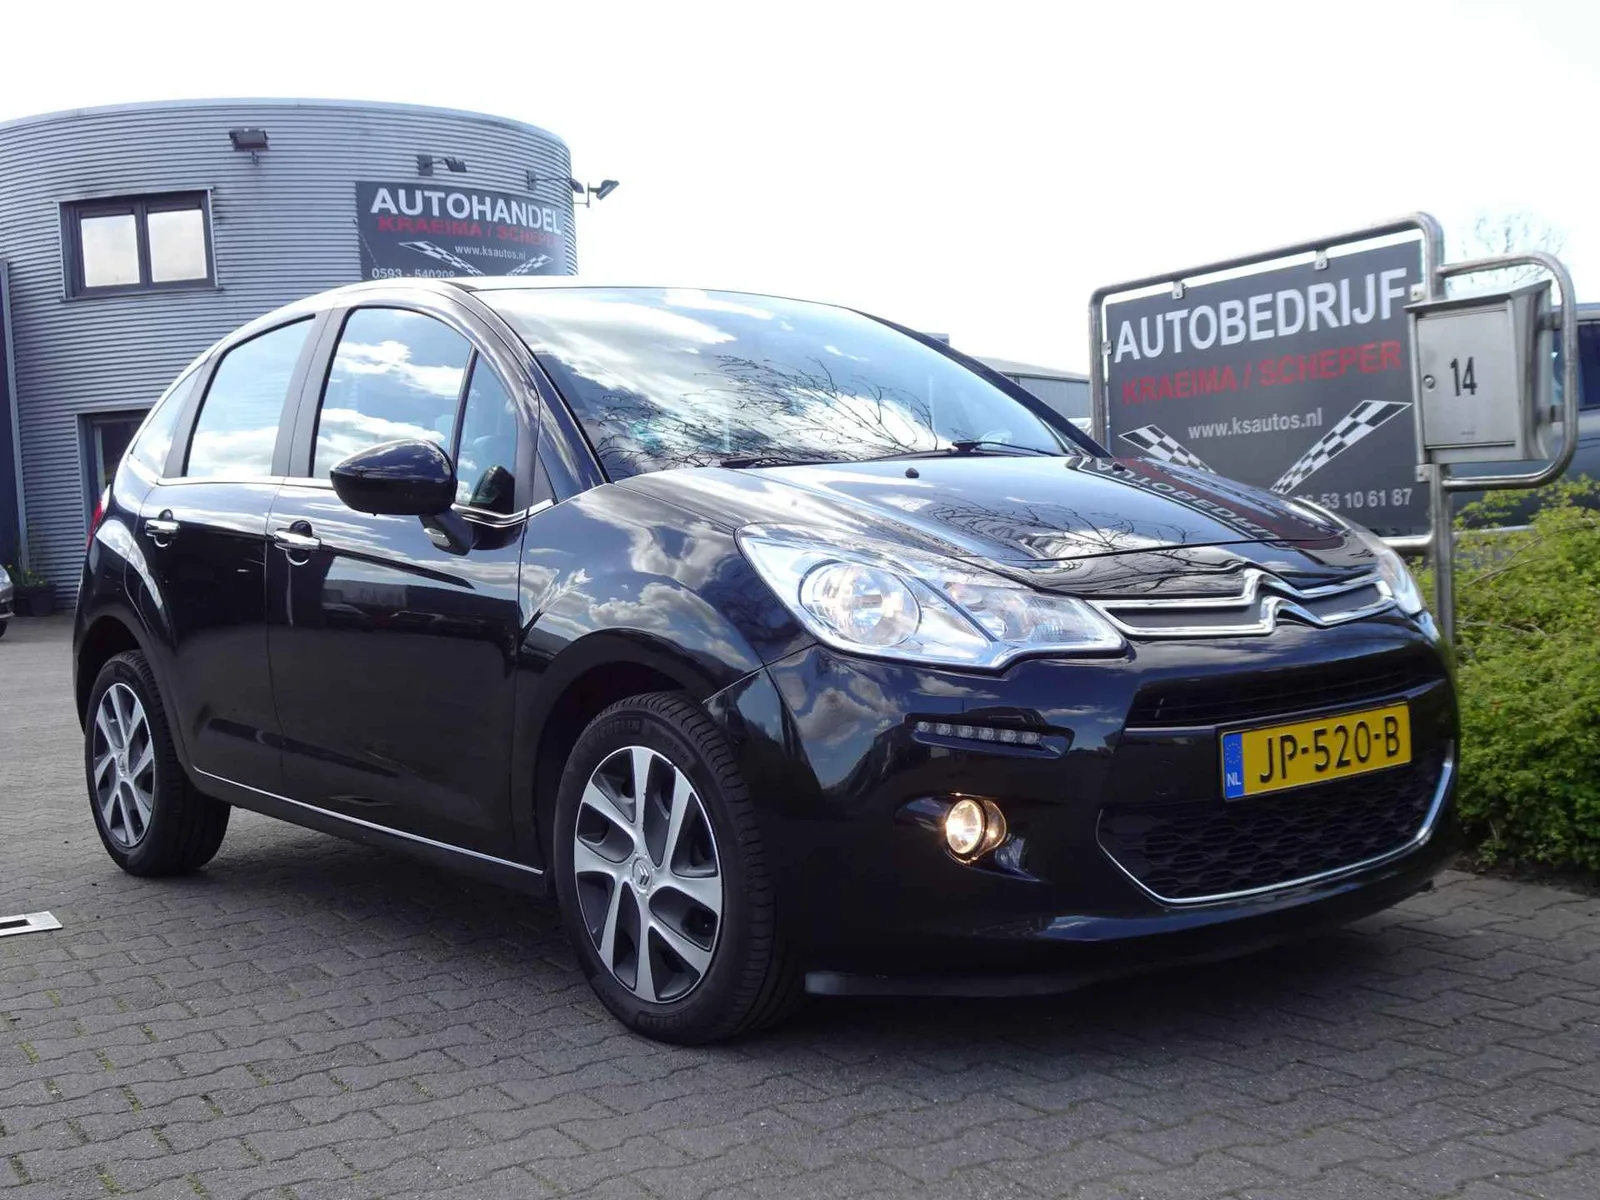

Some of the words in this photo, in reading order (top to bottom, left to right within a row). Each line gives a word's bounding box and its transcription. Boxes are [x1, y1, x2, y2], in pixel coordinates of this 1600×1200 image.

[370, 187, 562, 236] AUTOHANDEL
[377, 215, 482, 239] KRAEIMA
[455, 244, 526, 261] www.ksautos.nl
[1114, 267, 1408, 364] AUTOBEDRIJF
[1122, 364, 1237, 406] KRAEIMA
[1244, 362, 1252, 389] /
[1258, 340, 1401, 388] SCHEPER
[1450, 356, 1478, 397] 14
[1188, 407, 1323, 440] www.ksautos.nl
[1297, 492, 1341, 510] -53
[1344, 490, 1364, 509] 10
[1367, 489, 1387, 508] 61
[1391, 487, 1413, 506] 87
[1259, 715, 1402, 784] JP-520-B
[1226, 771, 1242, 788] NL
